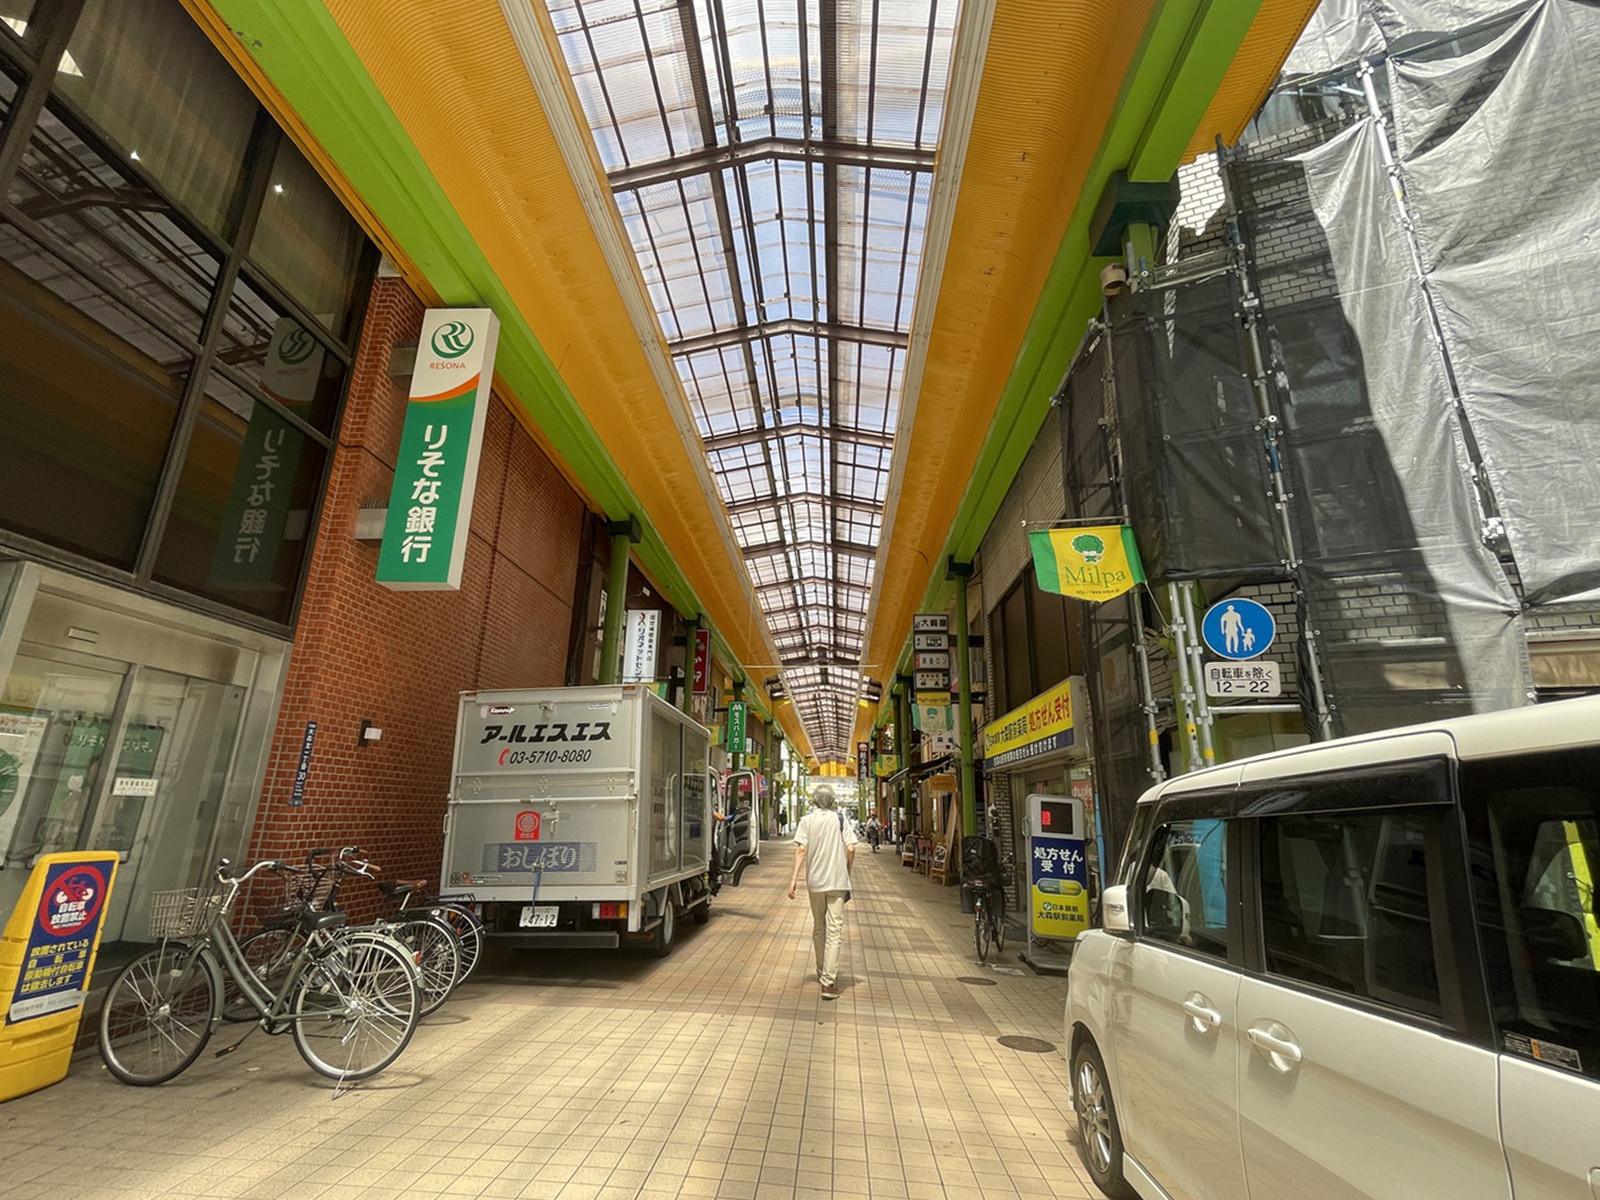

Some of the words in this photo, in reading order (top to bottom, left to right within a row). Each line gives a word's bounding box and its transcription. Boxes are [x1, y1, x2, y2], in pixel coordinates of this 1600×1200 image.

[429, 362, 466, 370] RESONA
[401, 425, 448, 562] りそな銀行
[1064, 565, 1126, 588] Milpa
[1210, 666, 1273, 680] 自転車を除く
[1029, 692, 1070, 732] 処方せん受付
[481, 722, 612, 744] アールエスエス
[733, 711, 741, 749] モスバーガー
[509, 749, 592, 765] 03-5710-8080
[297, 771, 306, 780] 30
[501, 845, 577, 869] おしぼり
[1034, 846, 1084, 863] 処方せん
[1041, 860, 1076, 875] 受付
[58, 901, 87, 914] 自転車
[51, 911, 88, 925] 放置禁止
[1036, 911, 1085, 923] 大森駅前薬局
[30, 939, 90, 957] 放置されている
[24, 960, 85, 981] 原動機付自転車
[20, 974, 73, 994] は撤去します
